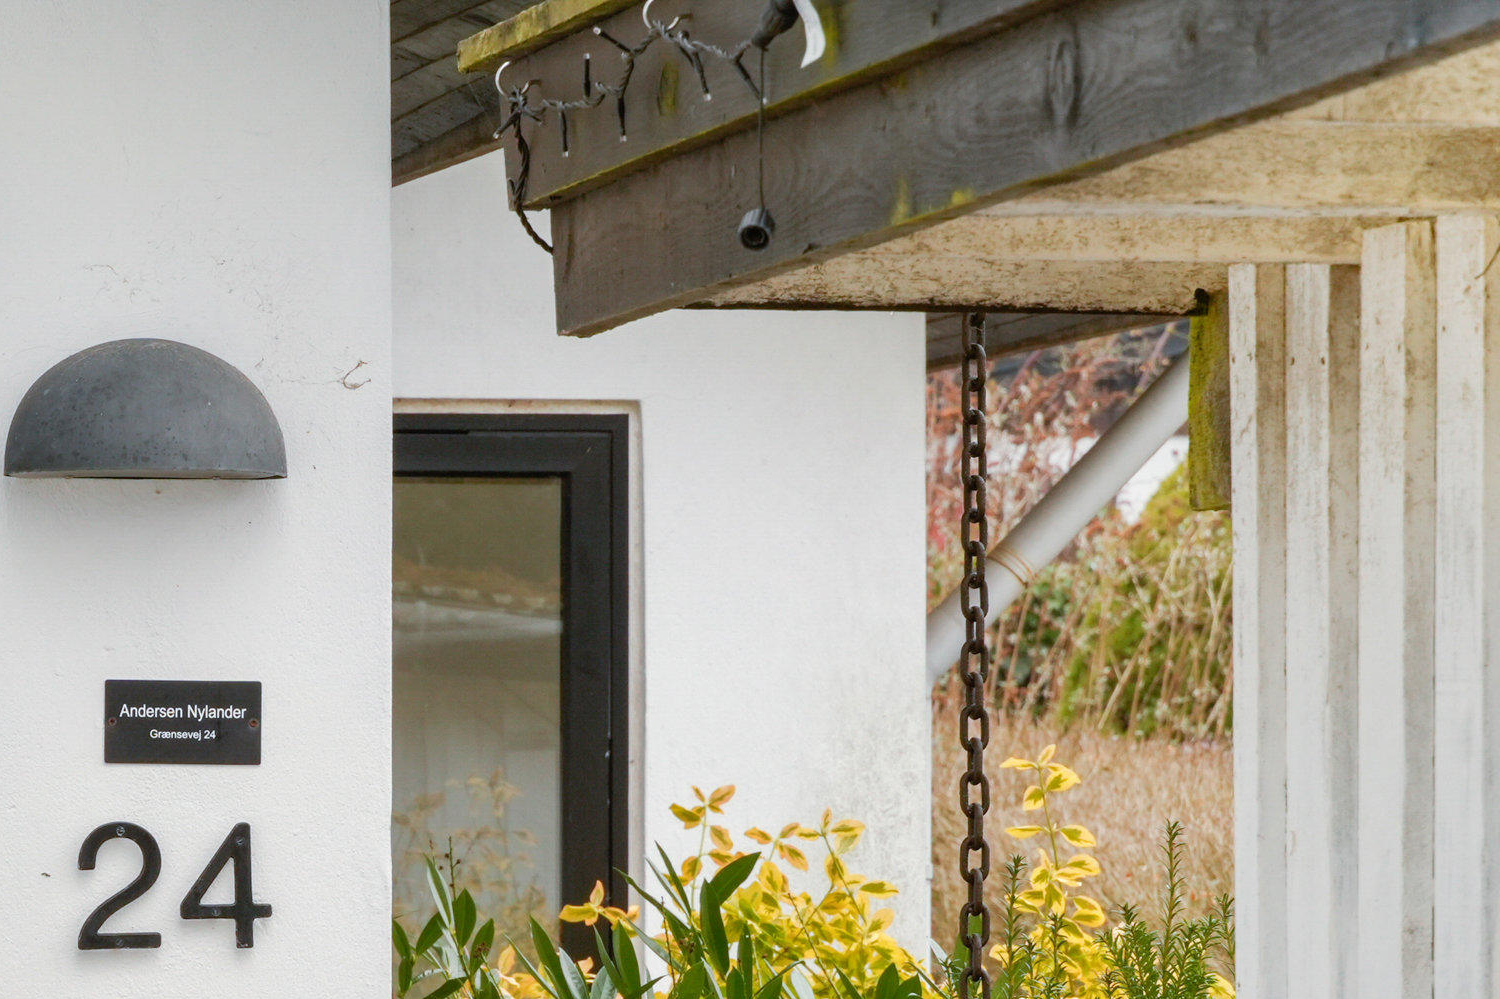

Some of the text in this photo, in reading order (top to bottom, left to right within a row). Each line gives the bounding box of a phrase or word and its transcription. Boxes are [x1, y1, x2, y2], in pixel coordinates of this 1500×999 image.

[119, 703, 247, 722] Andersen Nylander
[149, 729, 216, 741] Grænsevej 24
[77, 821, 273, 951] 24
